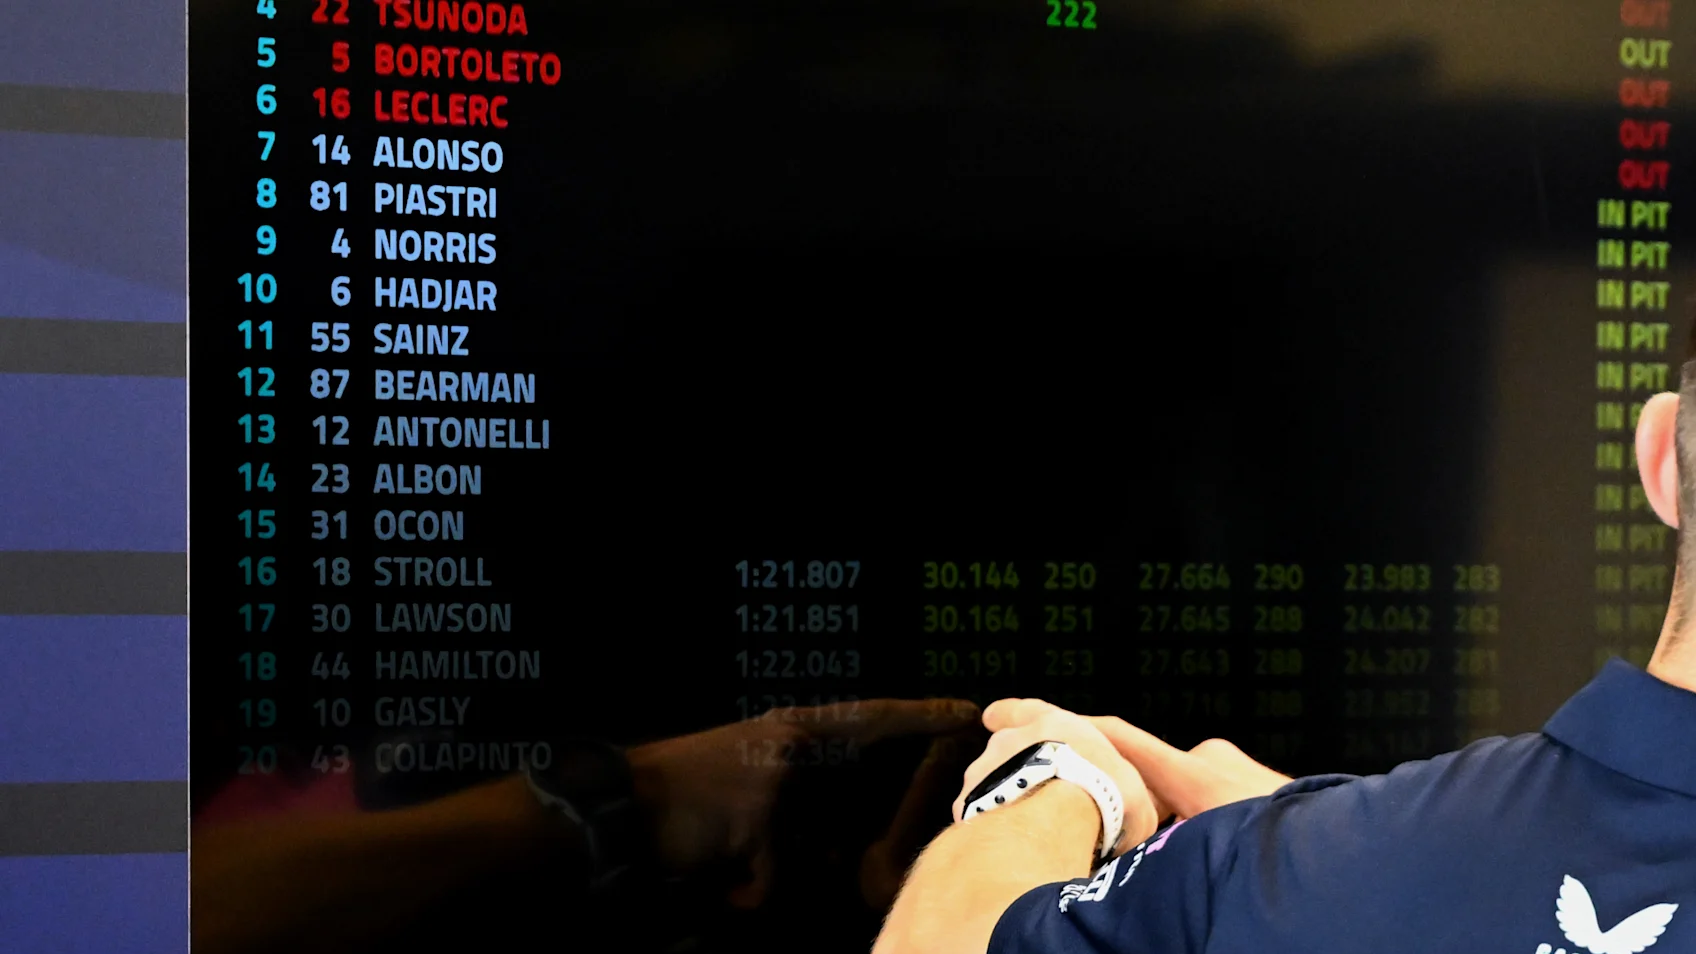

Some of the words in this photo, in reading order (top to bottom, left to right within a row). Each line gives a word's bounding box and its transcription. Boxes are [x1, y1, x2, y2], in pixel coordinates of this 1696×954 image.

[257, 0, 276, 19] 4
[312, 0, 350, 24] 22
[376, 0, 528, 36] TSUNODA
[1047, 0, 1097, 29] 222
[1618, 37, 1672, 69] OUT
[257, 37, 276, 68] 5
[333, 42, 349, 72] 5
[375, 44, 561, 85] BORTOLETO
[1618, 118, 1672, 150] OUT
[257, 84, 277, 115] 6
[313, 88, 350, 118] 16
[375, 90, 509, 128] LECLERC
[1617, 158, 1672, 191] OUT
[258, 131, 276, 161] 7
[312, 134, 350, 164] 14
[373, 136, 504, 173] ALONSO
[1630, 200, 1672, 231] PIT
[257, 177, 277, 208] 8
[310, 180, 348, 211] 81
[374, 183, 497, 218] PIASTRI
[1630, 241, 1672, 270] PIT
[257, 225, 277, 256] 9
[332, 228, 350, 258] 4
[374, 229, 497, 264] NORRIS
[238, 272, 277, 304] 10
[331, 276, 351, 306] 6
[374, 277, 497, 312] HADJAR
[238, 320, 273, 350] 11
[311, 322, 350, 353] 55
[373, 323, 469, 356] SAINZ
[238, 367, 275, 397] 12
[310, 368, 350, 399] 87
[374, 370, 536, 403] BEARMAN
[238, 414, 276, 444] 13
[312, 416, 350, 446] 12
[373, 416, 550, 449] ANTONELLI
[238, 462, 276, 492] 14
[311, 464, 350, 494] 23
[373, 464, 481, 495] ALBON
[238, 510, 276, 539] 15
[311, 510, 347, 540] 31
[374, 510, 464, 541] OCON
[238, 556, 277, 586] 16
[312, 557, 351, 586] 18
[374, 557, 493, 587] STROLL
[735, 559, 862, 589] 1:21.807
[923, 560, 1021, 590] 30.144
[1044, 560, 1097, 590] 250
[1138, 562, 1232, 592] 27.664
[238, 603, 276, 632] 17
[311, 603, 351, 633] 30
[375, 603, 512, 633] LAWSON
[736, 604, 860, 634] 1:21.851
[923, 604, 1021, 634] 30.164
[1044, 604, 1095, 634] 251
[239, 651, 277, 681] 18
[311, 651, 351, 681] 44
[375, 650, 541, 680] HAMILTON
[735, 648, 862, 679] 1:22.043
[239, 698, 277, 728] 19
[313, 697, 352, 727] 10
[375, 697, 472, 727] GASLY
[311, 744, 351, 773] 43
[375, 741, 553, 772] COLAPINTO
